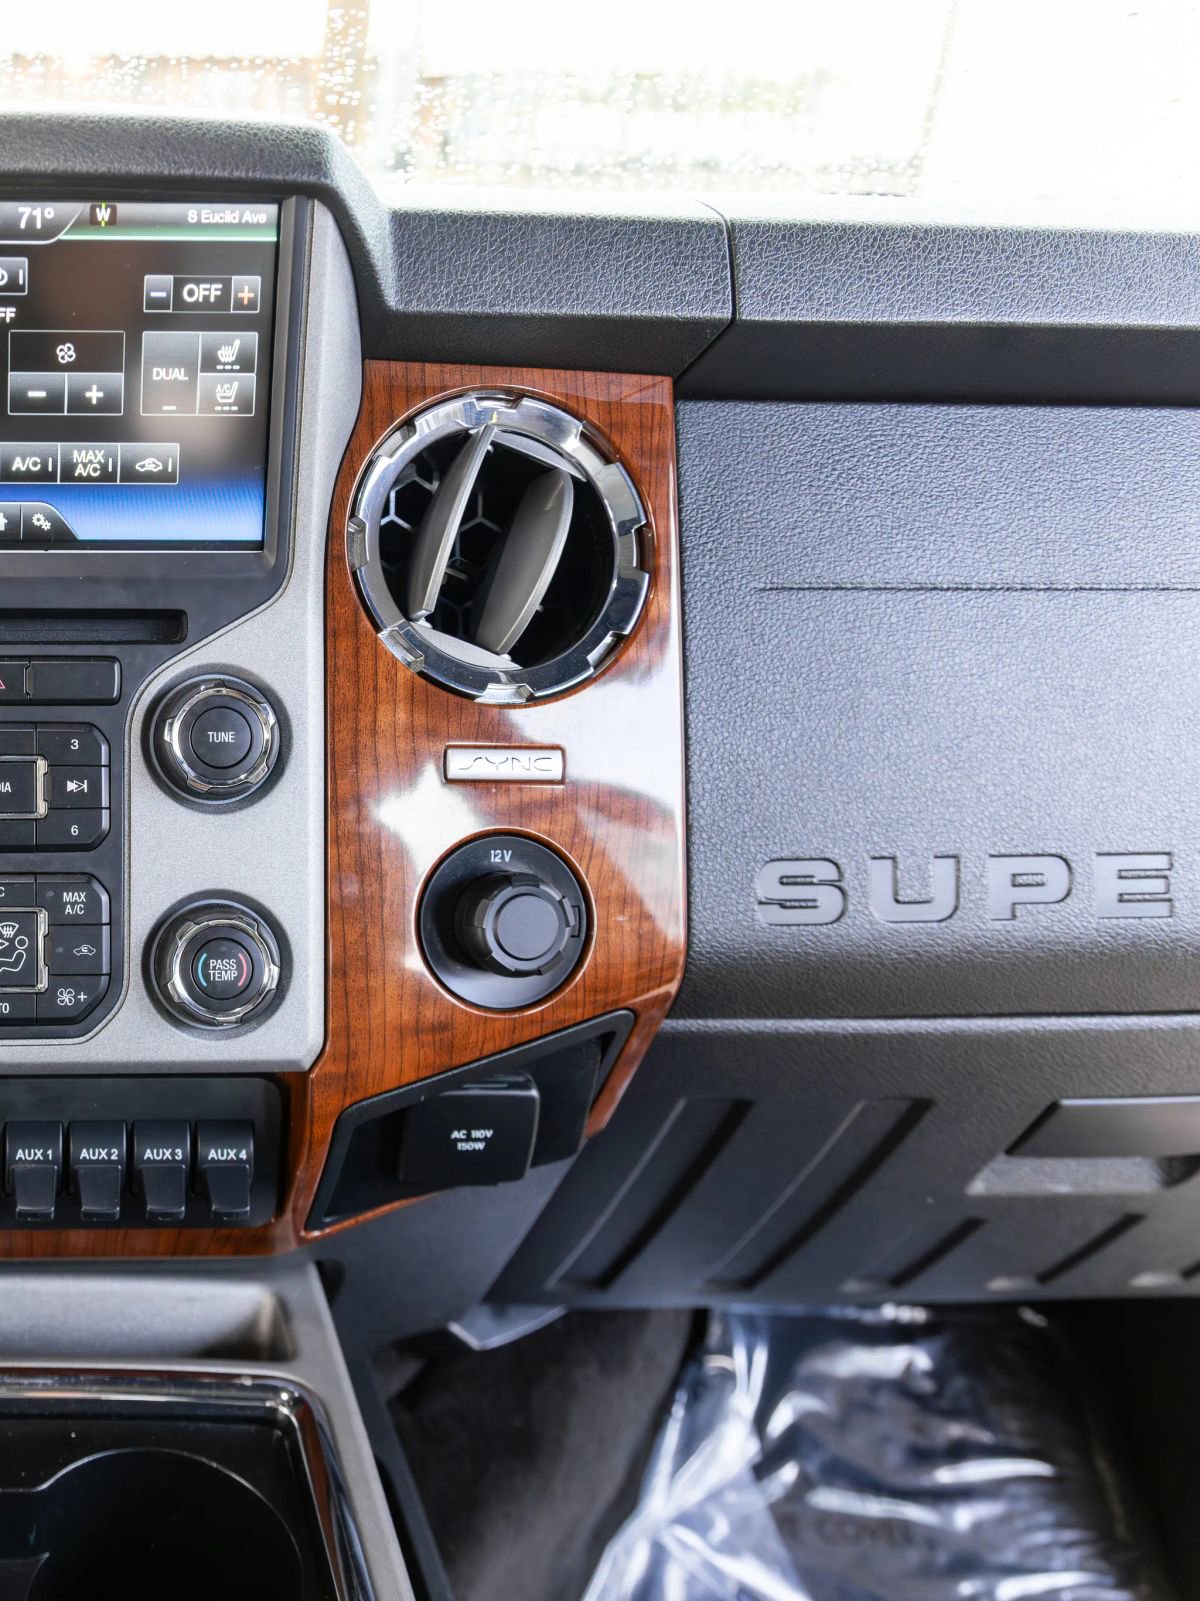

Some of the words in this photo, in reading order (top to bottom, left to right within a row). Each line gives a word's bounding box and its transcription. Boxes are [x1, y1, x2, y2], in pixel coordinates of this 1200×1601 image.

[96, 207, 112, 221] W
[188, 210, 198, 223] S
[201, 210, 239, 223] Euclid
[242, 210, 267, 223] Ave
[183, 284, 222, 302] OFF
[152, 367, 189, 380] DUAL
[73, 450, 104, 463] MAX
[12, 457, 41, 472] A/C
[75, 463, 101, 477] A/C
[207, 730, 236, 743] TUNE
[71, 739, 79, 750] 3
[459, 756, 552, 772] SYNC
[71, 825, 79, 836] 6
[63, 892, 86, 904] MAX
[65, 905, 84, 915] A/C
[210, 960, 236, 971] PASS
[209, 971, 237, 982] TEMP
[451, 1130, 467, 1139] AC
[471, 1129, 493, 1139] 110V
[457, 1141, 485, 1150] 150W
[16, 1148, 43, 1161] AUX
[46, 1149, 52, 1160] 1
[80, 1148, 107, 1161] AUX
[108, 1149, 117, 1160] 2
[144, 1148, 171, 1161] AUX
[173, 1149, 182, 1160] 3
[208, 1148, 236, 1161] AUX
[237, 1149, 247, 1160] 4
